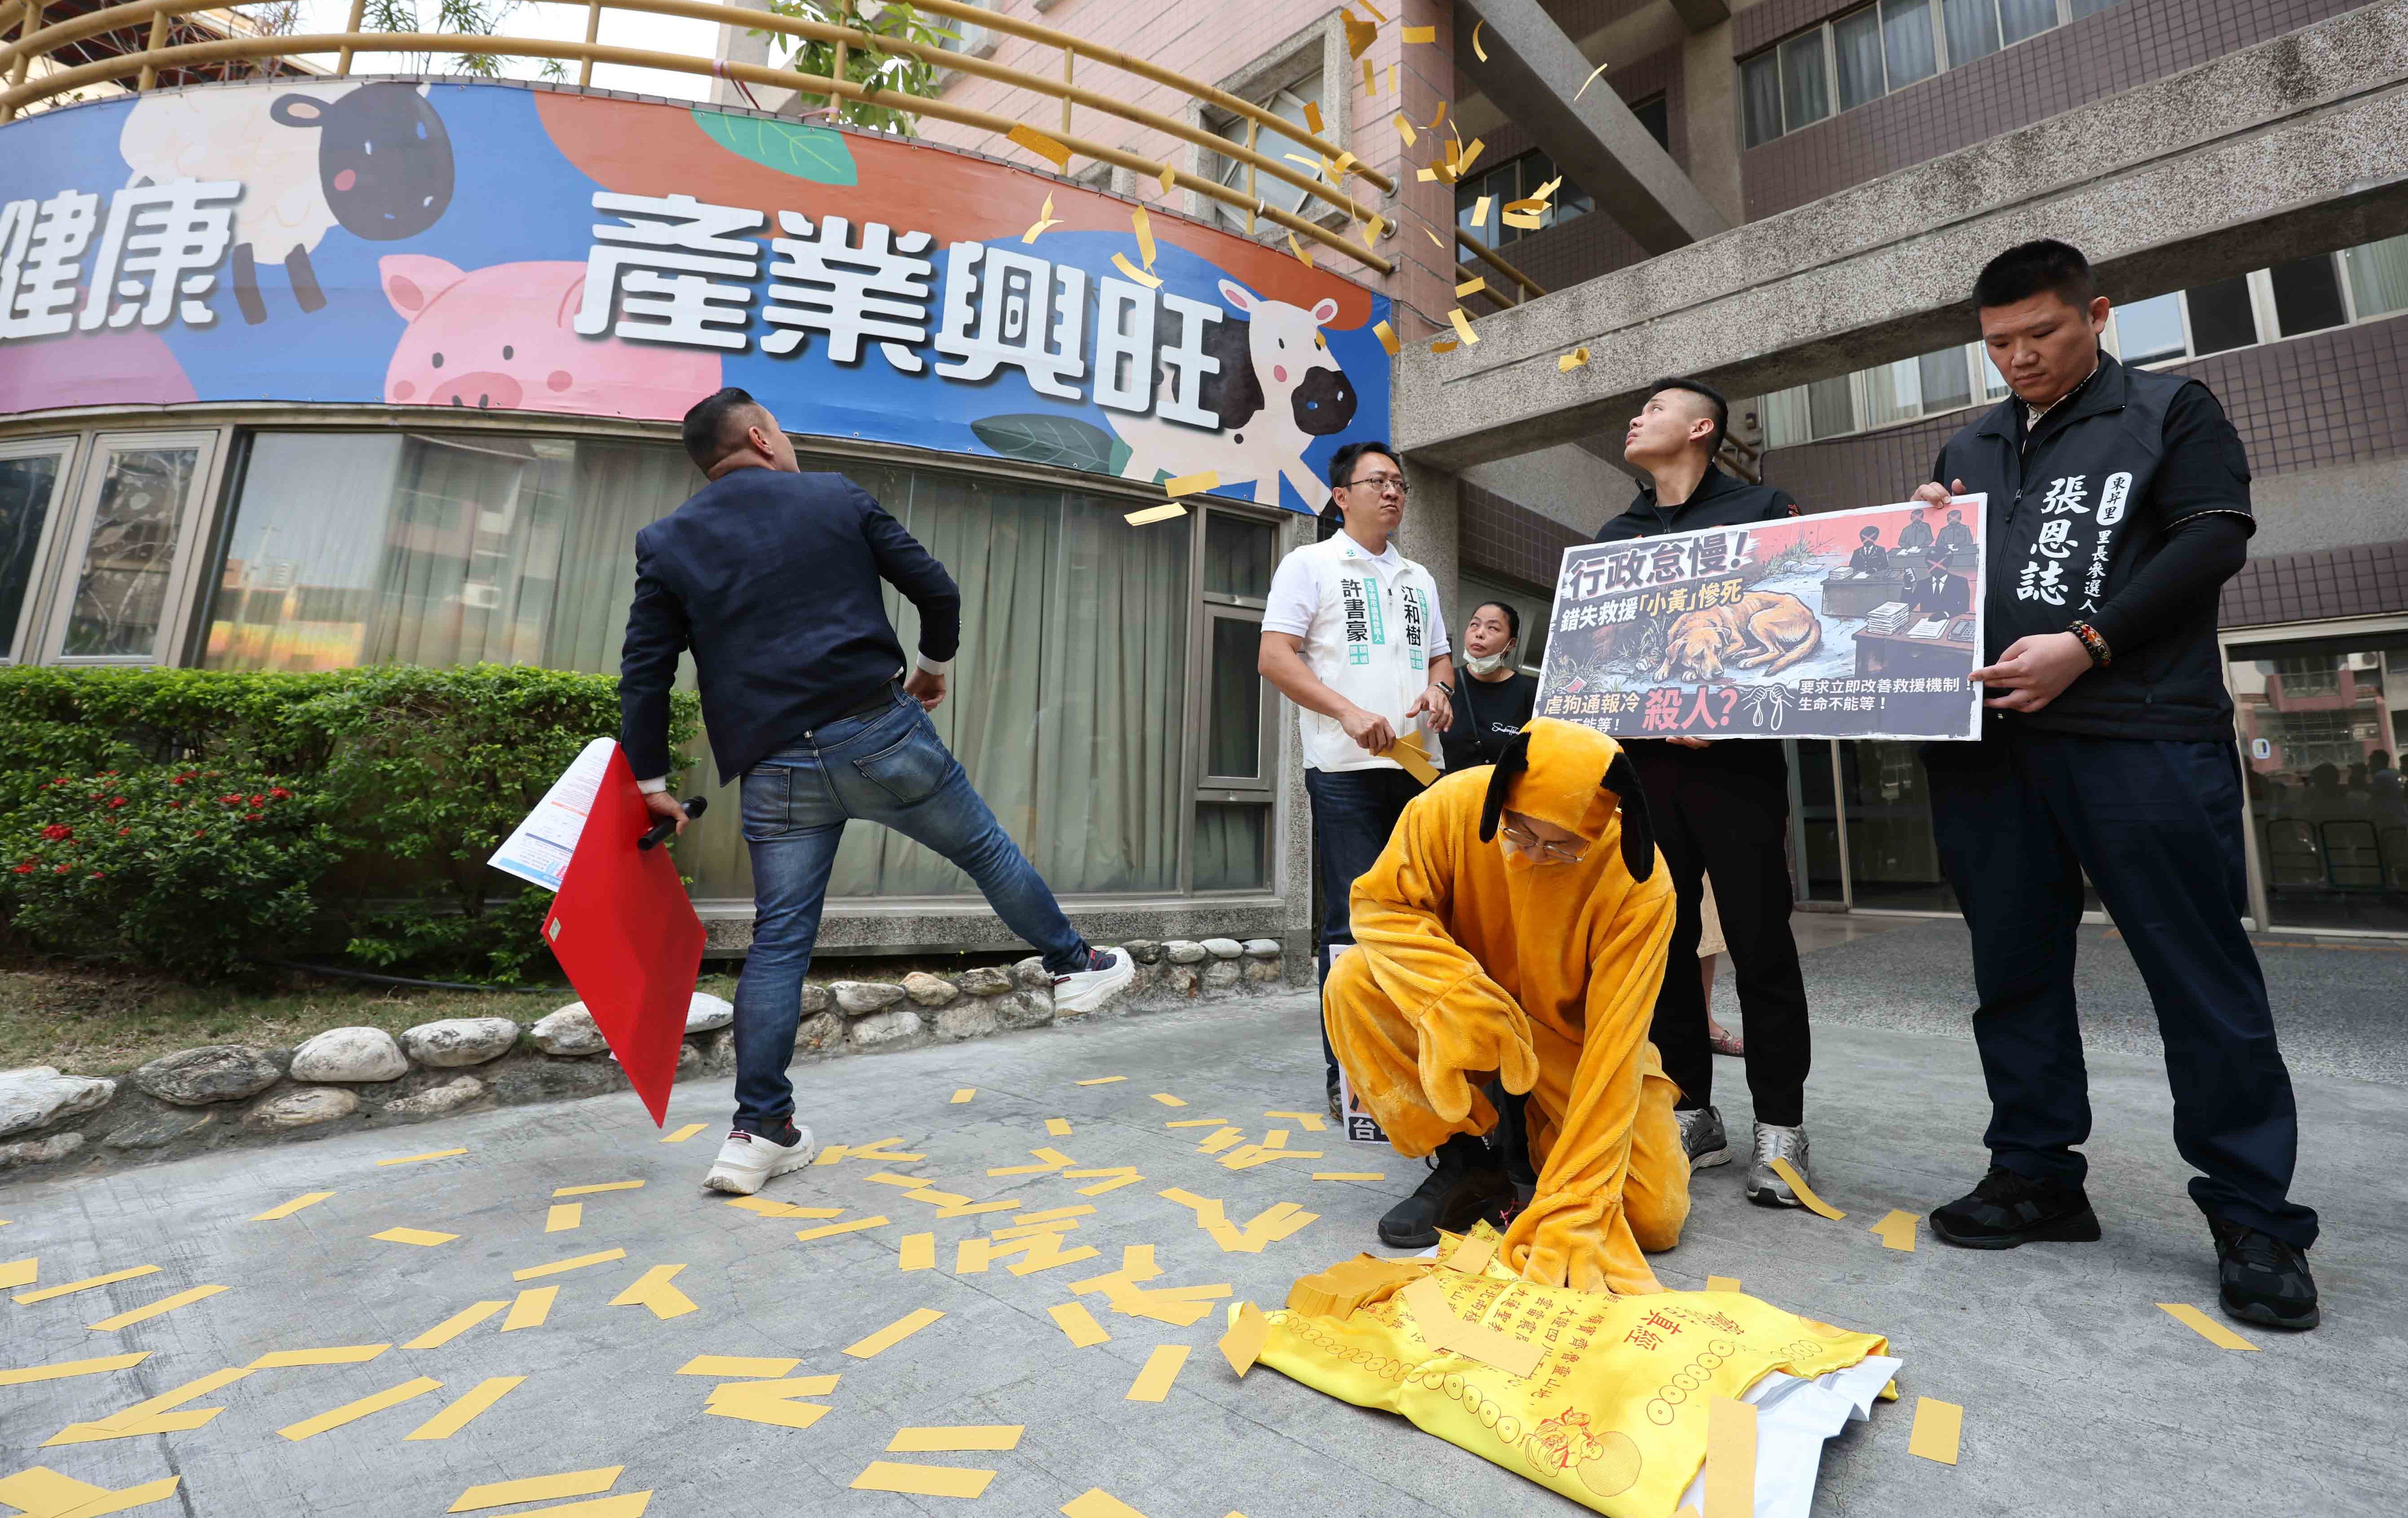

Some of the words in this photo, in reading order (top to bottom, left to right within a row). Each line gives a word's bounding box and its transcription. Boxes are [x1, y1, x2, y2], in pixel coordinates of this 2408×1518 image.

[0, 177, 241, 339] 健康
[573, 191, 1223, 429] 產業興旺
[1570, 531, 1749, 599] 行政怠慢!
[2016, 474, 2091, 606] 張恩誌
[2078, 530, 2112, 614] 里長參選人
[1340, 579, 1368, 642] 許書豪
[1401, 585, 1421, 646] 江和樹
[1560, 578, 1743, 632] 錯失救援「小黃」慘死
[1544, 692, 1640, 715] 虐狗通報冷
[1642, 687, 1738, 731] 殺人?
[1798, 696, 1886, 711] 生命不能等！
[1799, 677, 1971, 694] 要求立即改善救援機制！
[1560, 717, 1620, 733] 不能等！
[1623, 1309, 1682, 1350] 真經
